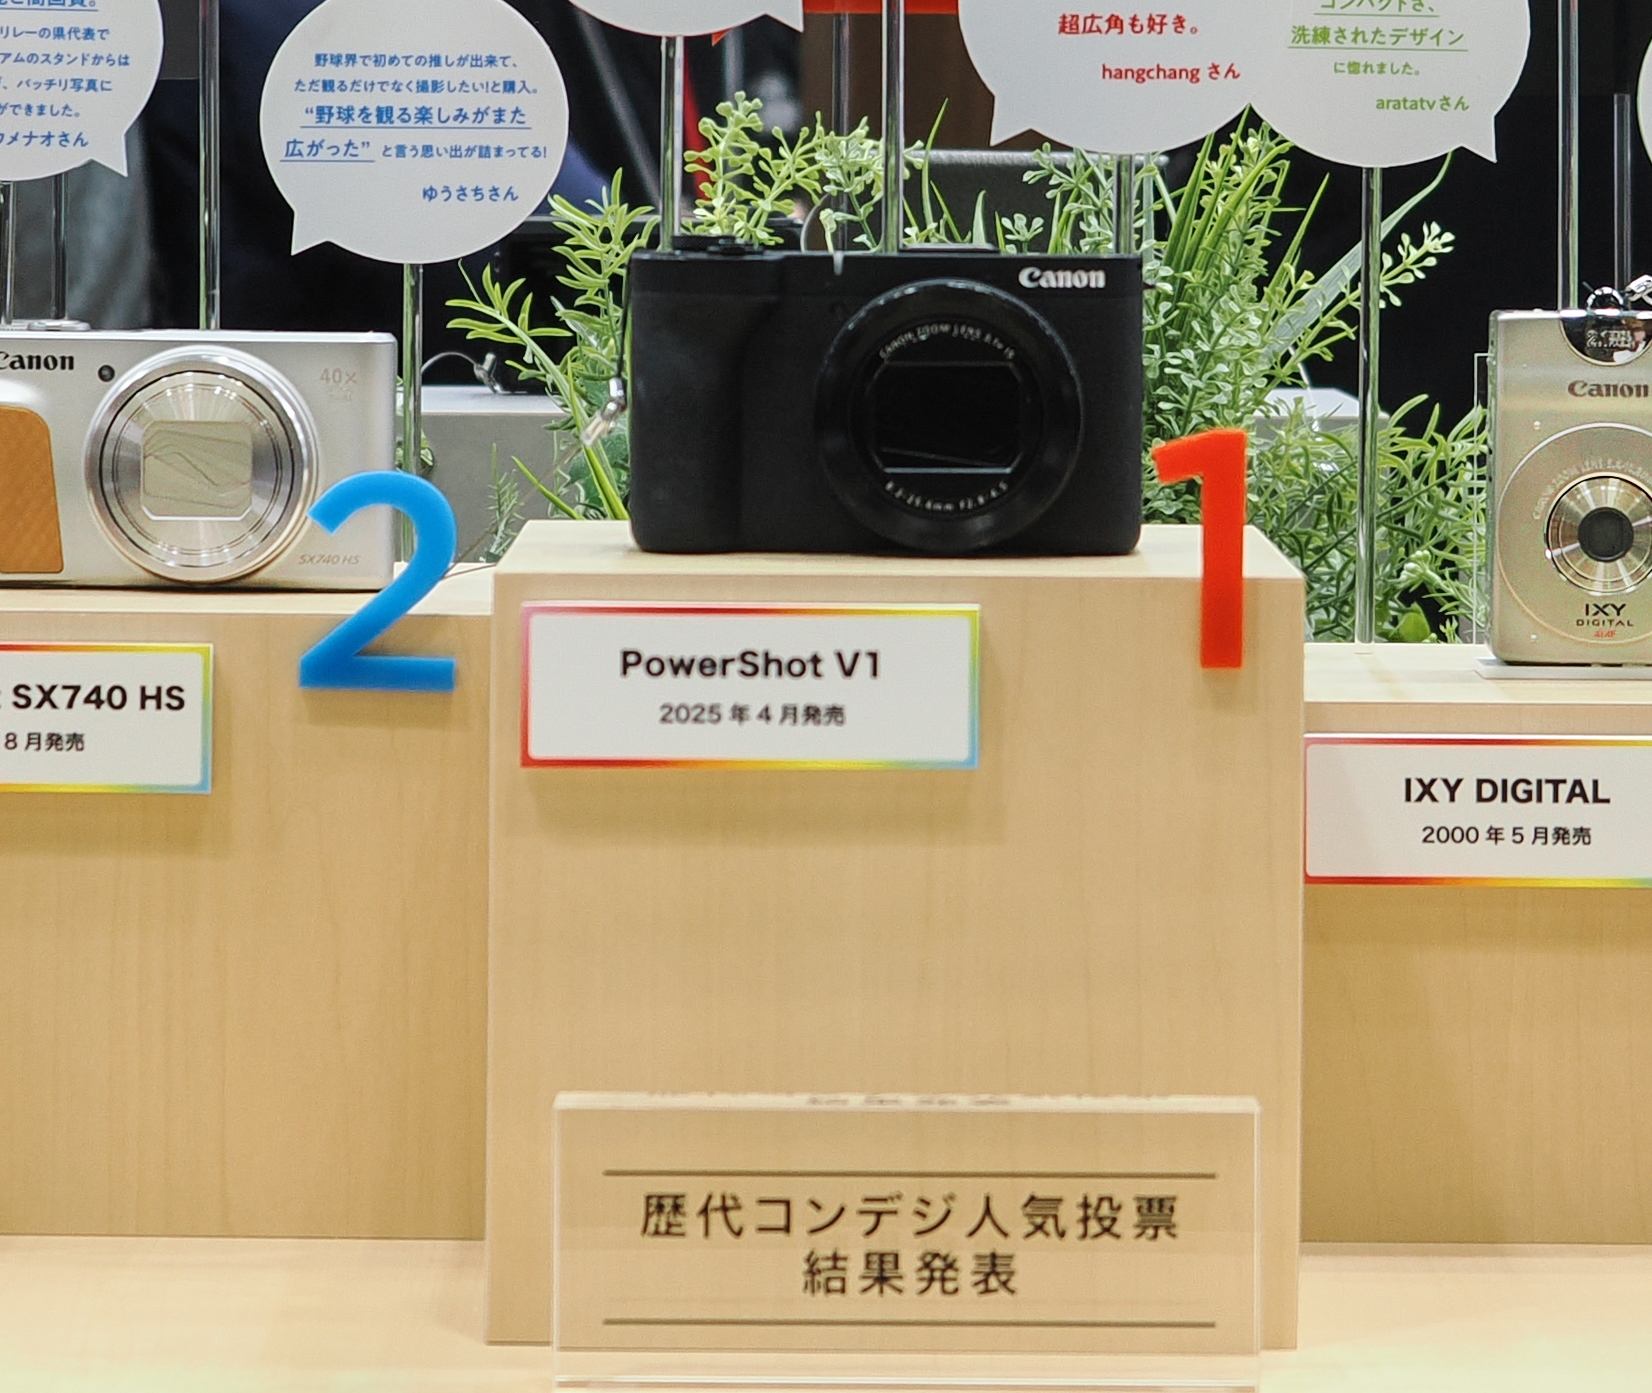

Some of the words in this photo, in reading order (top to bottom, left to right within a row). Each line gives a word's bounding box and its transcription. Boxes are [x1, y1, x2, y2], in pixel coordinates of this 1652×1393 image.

[1059, 14, 1197, 34] 超広角も好き。
[1292, 25, 1463, 46] 洗練されたデザイン
[1102, 64, 1200, 83] hangchang
[1208, 63, 1240, 80] さん
[1334, 61, 1419, 75] に惚れました。
[423, 186, 518, 202] ゆうさちさん
[1019, 267, 1105, 289] Canon
[1568, 380, 1649, 400] Canon
[1152, 429, 1247, 669] 1
[298, 470, 457, 691] 2
[1585, 603, 1626, 616] IXY
[622, 651, 822, 677] PowerShot
[836, 652, 877, 677] V1
[13, 684, 127, 710] SX740
[140, 686, 184, 710] HS
[1405, 778, 1463, 802] IXY
[1477, 779, 1610, 803] DIGITAL
[642, 1194, 1176, 1240] 歴代コンデジ人気投票
[804, 1250, 1015, 1295] 結果発表
